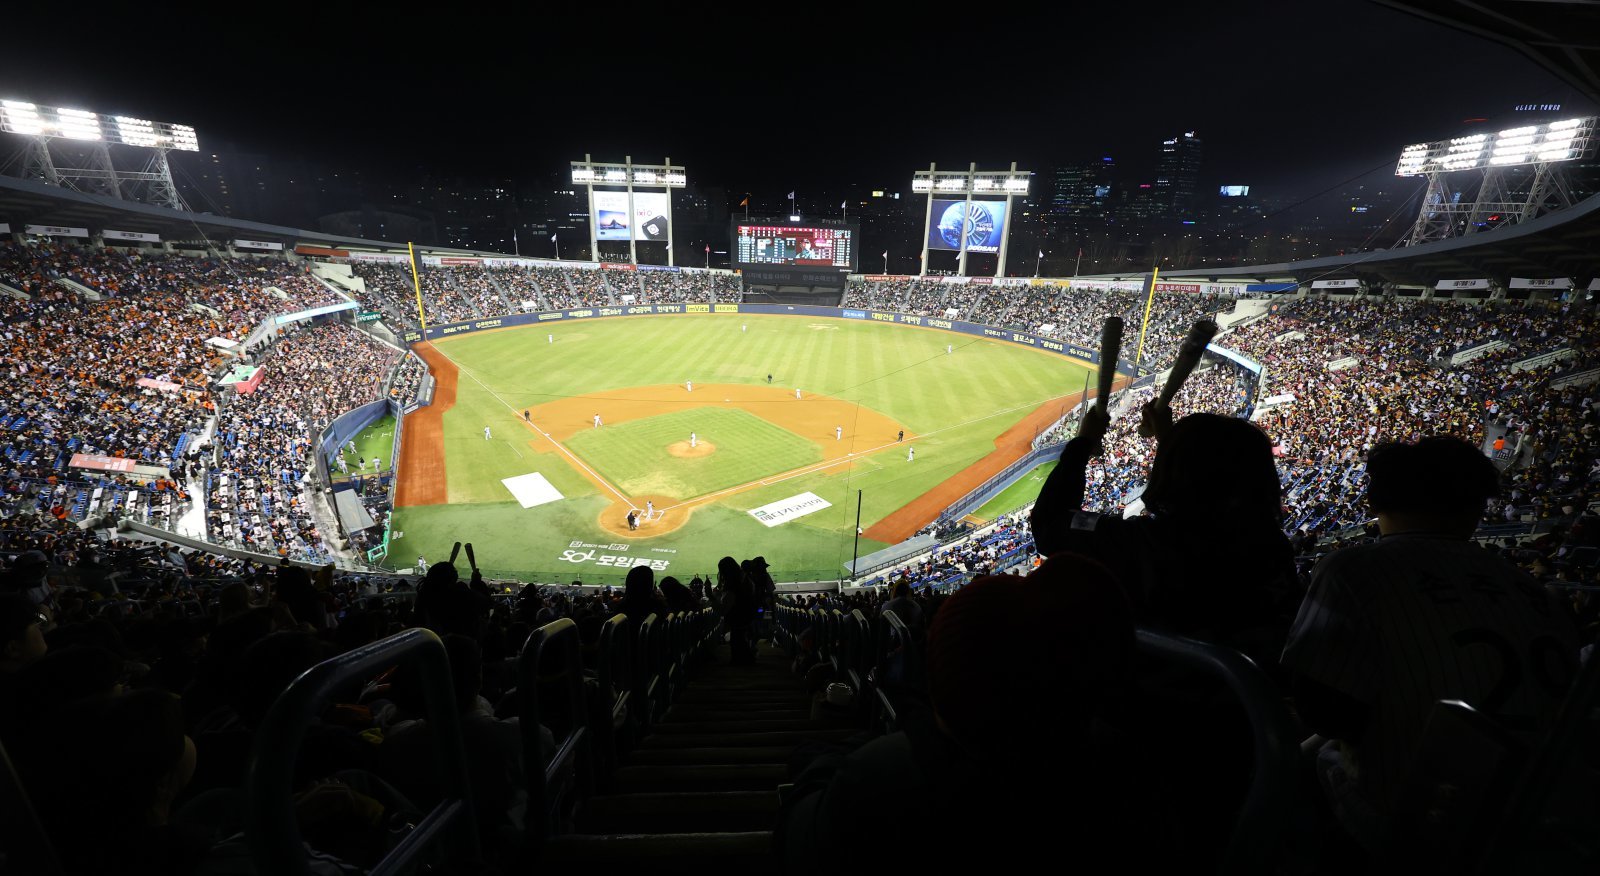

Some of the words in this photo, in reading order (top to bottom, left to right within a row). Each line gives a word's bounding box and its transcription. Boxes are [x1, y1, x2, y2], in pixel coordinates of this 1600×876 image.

[871, 312, 895, 322] 대방건설
[900, 315, 922, 325] 로제비앙
[558, 549, 598, 563] SOL
[595, 555, 671, 571] 모임통장
